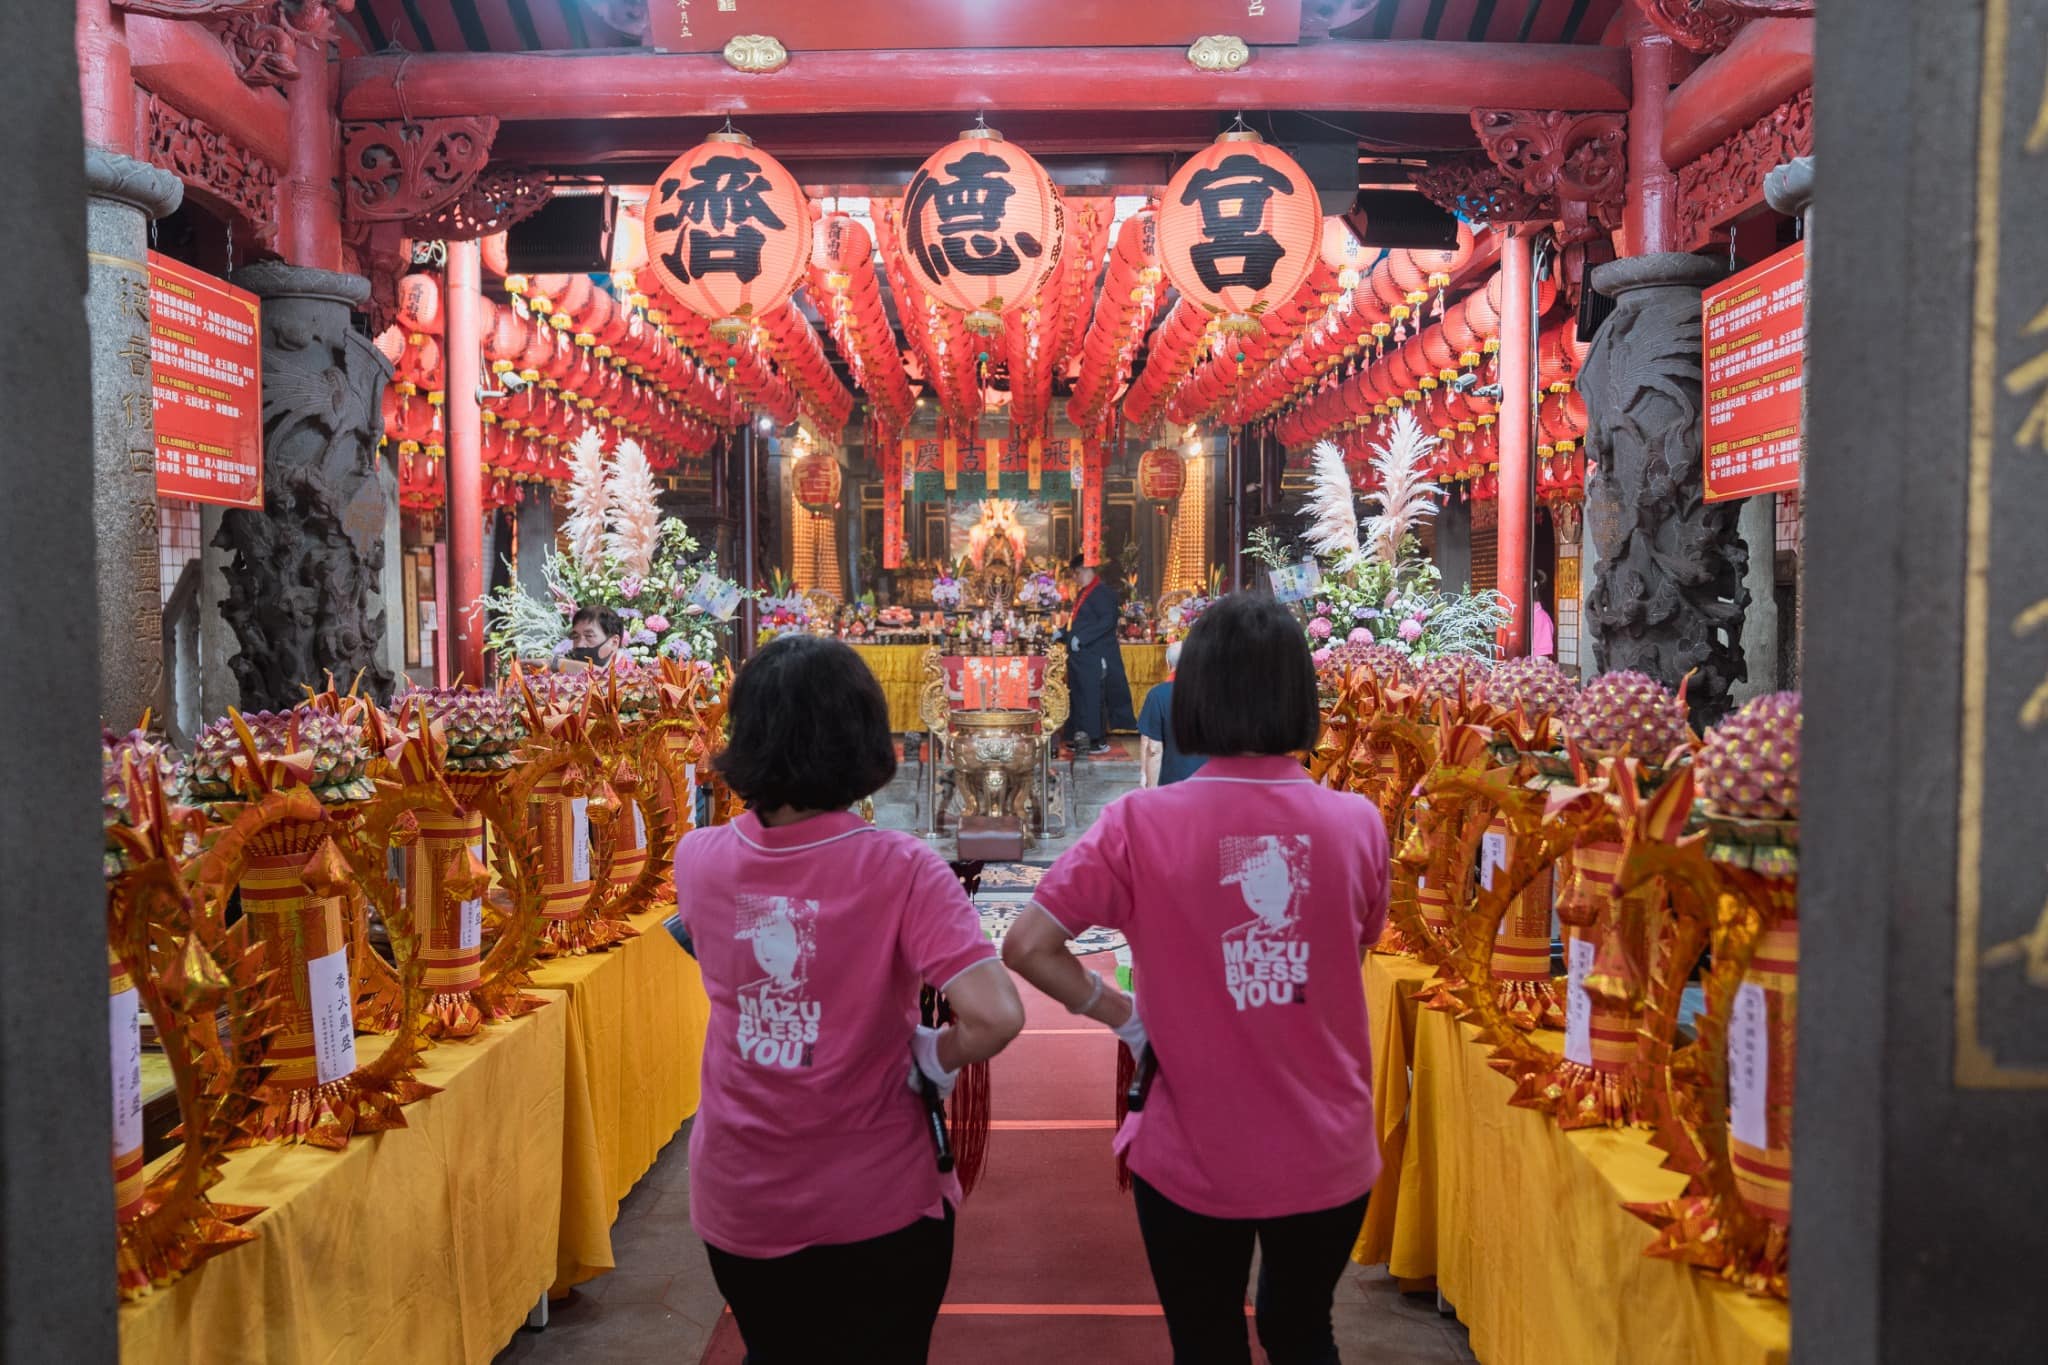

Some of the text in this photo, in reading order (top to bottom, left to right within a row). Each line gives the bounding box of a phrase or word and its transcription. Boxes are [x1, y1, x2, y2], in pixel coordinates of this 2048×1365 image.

[652, 155, 787, 285] 濟
[901, 151, 1044, 285] 德
[1180, 153, 1295, 294] 宮
[1222, 940, 1309, 964] MAZU
[1225, 962, 1309, 986] BLESS
[737, 994, 821, 1023] MAZU
[1228, 981, 1293, 1011] YOU
[738, 1014, 820, 1044] BLESS
[736, 1034, 802, 1069] YOU
